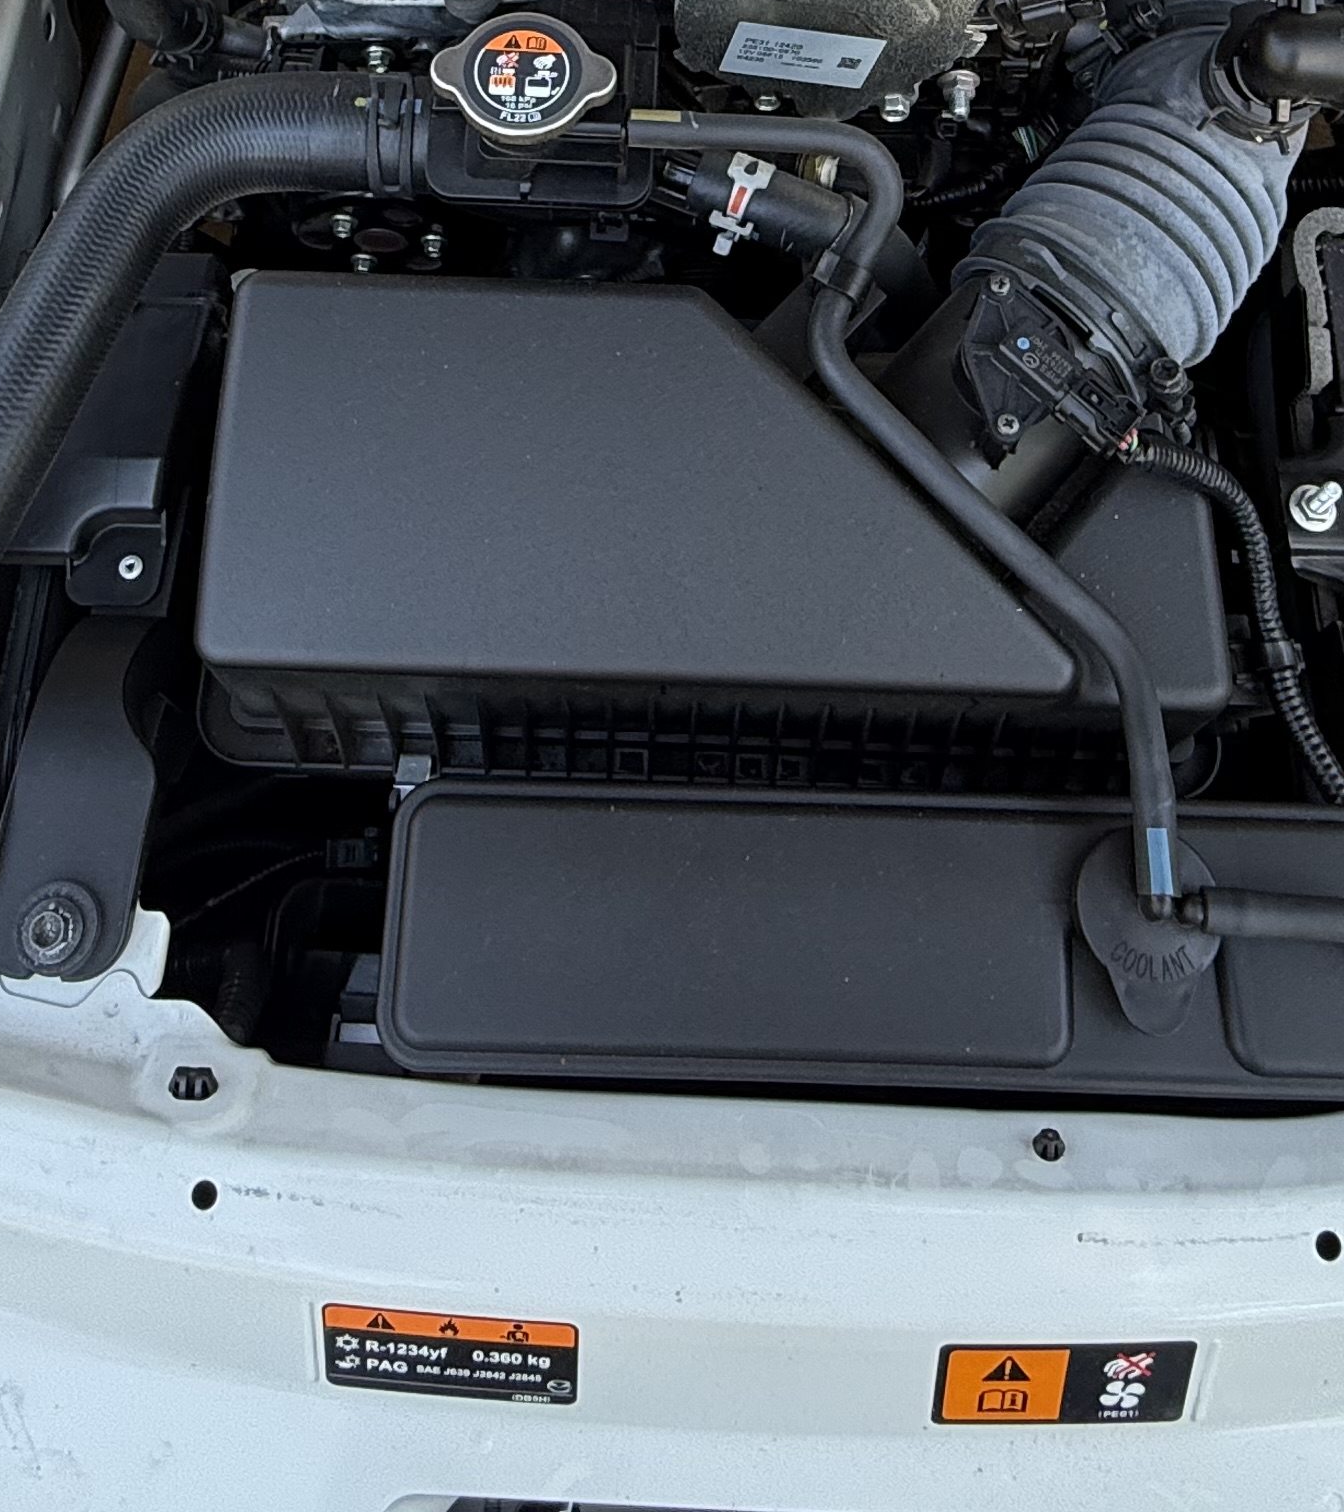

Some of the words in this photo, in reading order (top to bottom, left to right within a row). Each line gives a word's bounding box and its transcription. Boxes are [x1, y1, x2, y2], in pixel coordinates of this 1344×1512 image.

[499, 111, 526, 123] FL22
[1110, 941, 1196, 984] COOLANT
[365, 1339, 448, 1360] R-1234yf
[527, 1353, 551, 1369] kg
[366, 1358, 408, 1374] PAG
